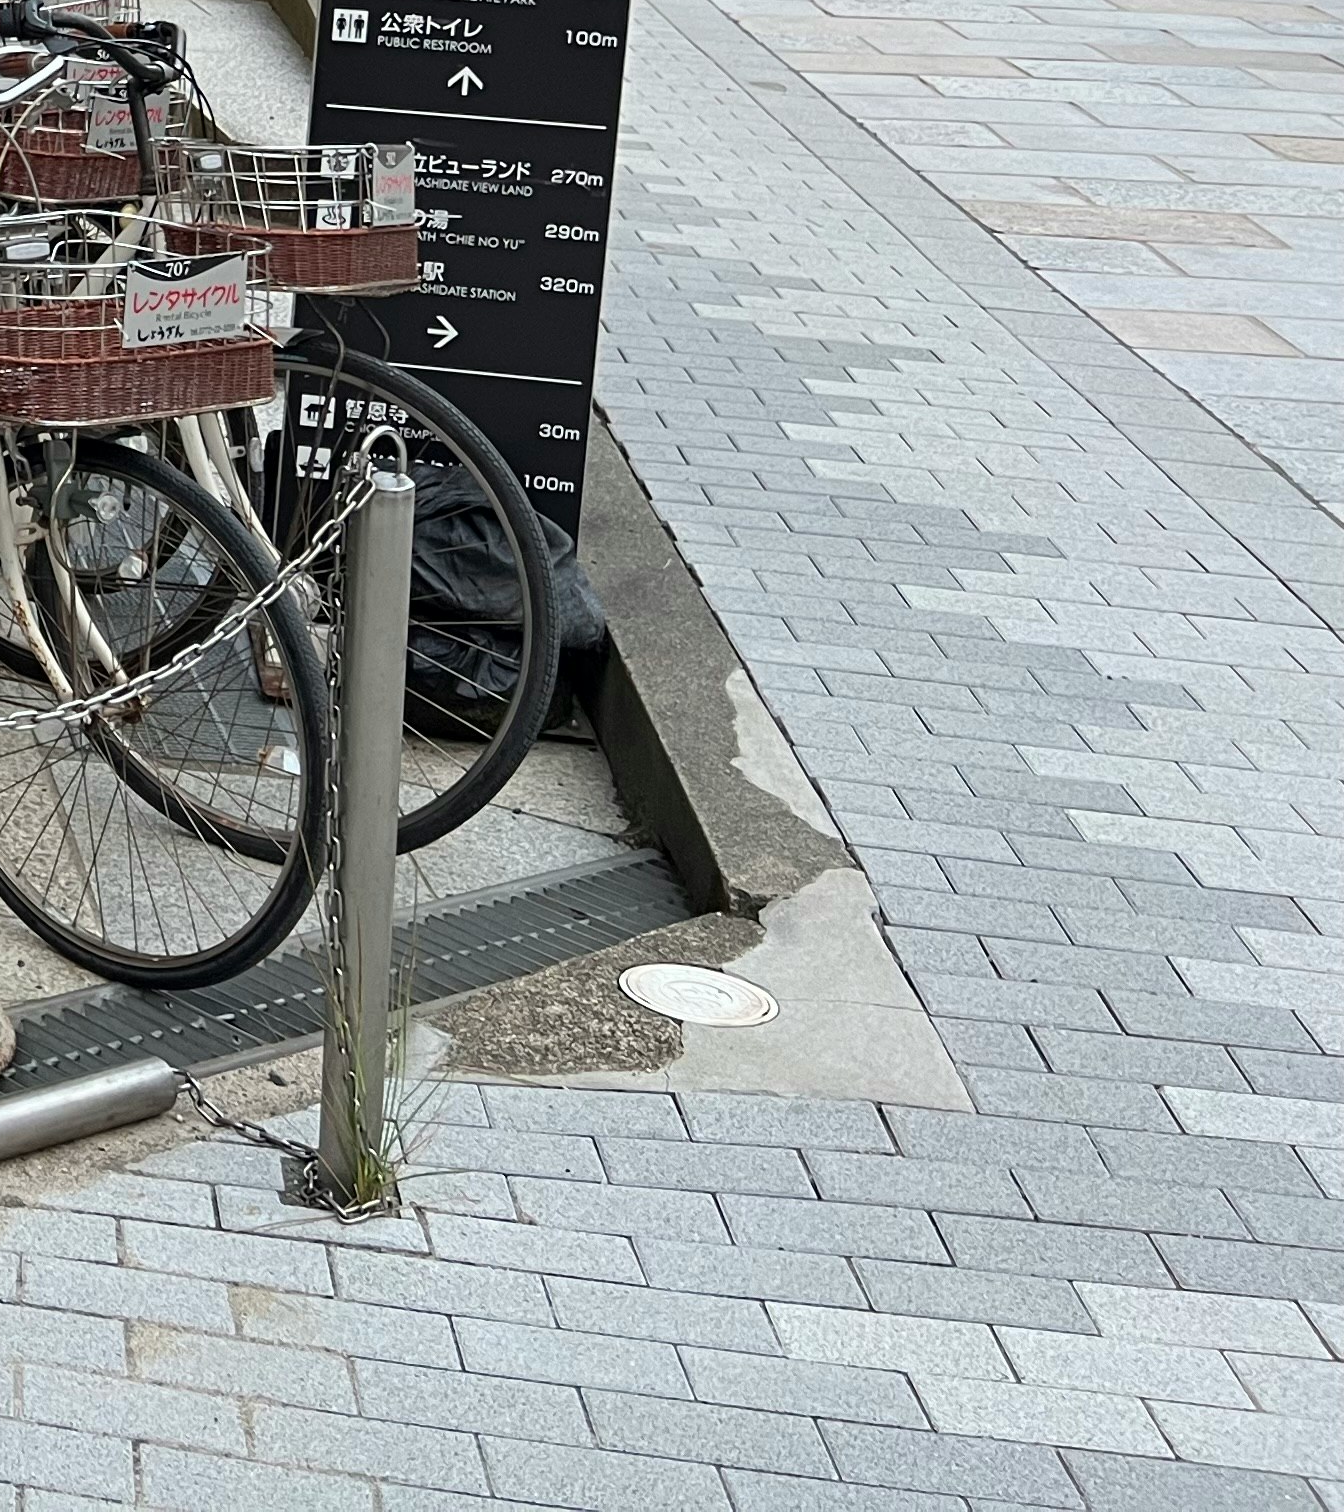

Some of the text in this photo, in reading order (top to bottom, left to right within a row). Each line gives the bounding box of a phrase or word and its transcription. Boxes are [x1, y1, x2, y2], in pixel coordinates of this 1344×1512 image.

[380, 12, 483, 38] 公衆トイレ
[377, 36, 492, 54] PUBLIC RESTROOM
[565, 29, 618, 48] 100m
[95, 107, 163, 127] レンタクル
[414, 154, 531, 180] 立ビューランド
[413, 177, 469, 192] HASHIDATE
[470, 181, 499, 193] VIEW
[501, 184, 533, 197] LAND
[551, 168, 604, 187] 270m
[413, 208, 449, 230] の湯
[416, 231, 436, 242] ATH
[477, 236, 500, 248] NO
[544, 224, 600, 242] 290m
[165, 261, 191, 277] 707
[412, 284, 516, 302] ASHIDATE STATION
[539, 276, 595, 295] 320m
[133, 283, 240, 314] レンタサイクル
[345, 398, 409, 424] 智恩寺
[538, 423, 580, 440] 30m
[523, 474, 575, 493] 100m
